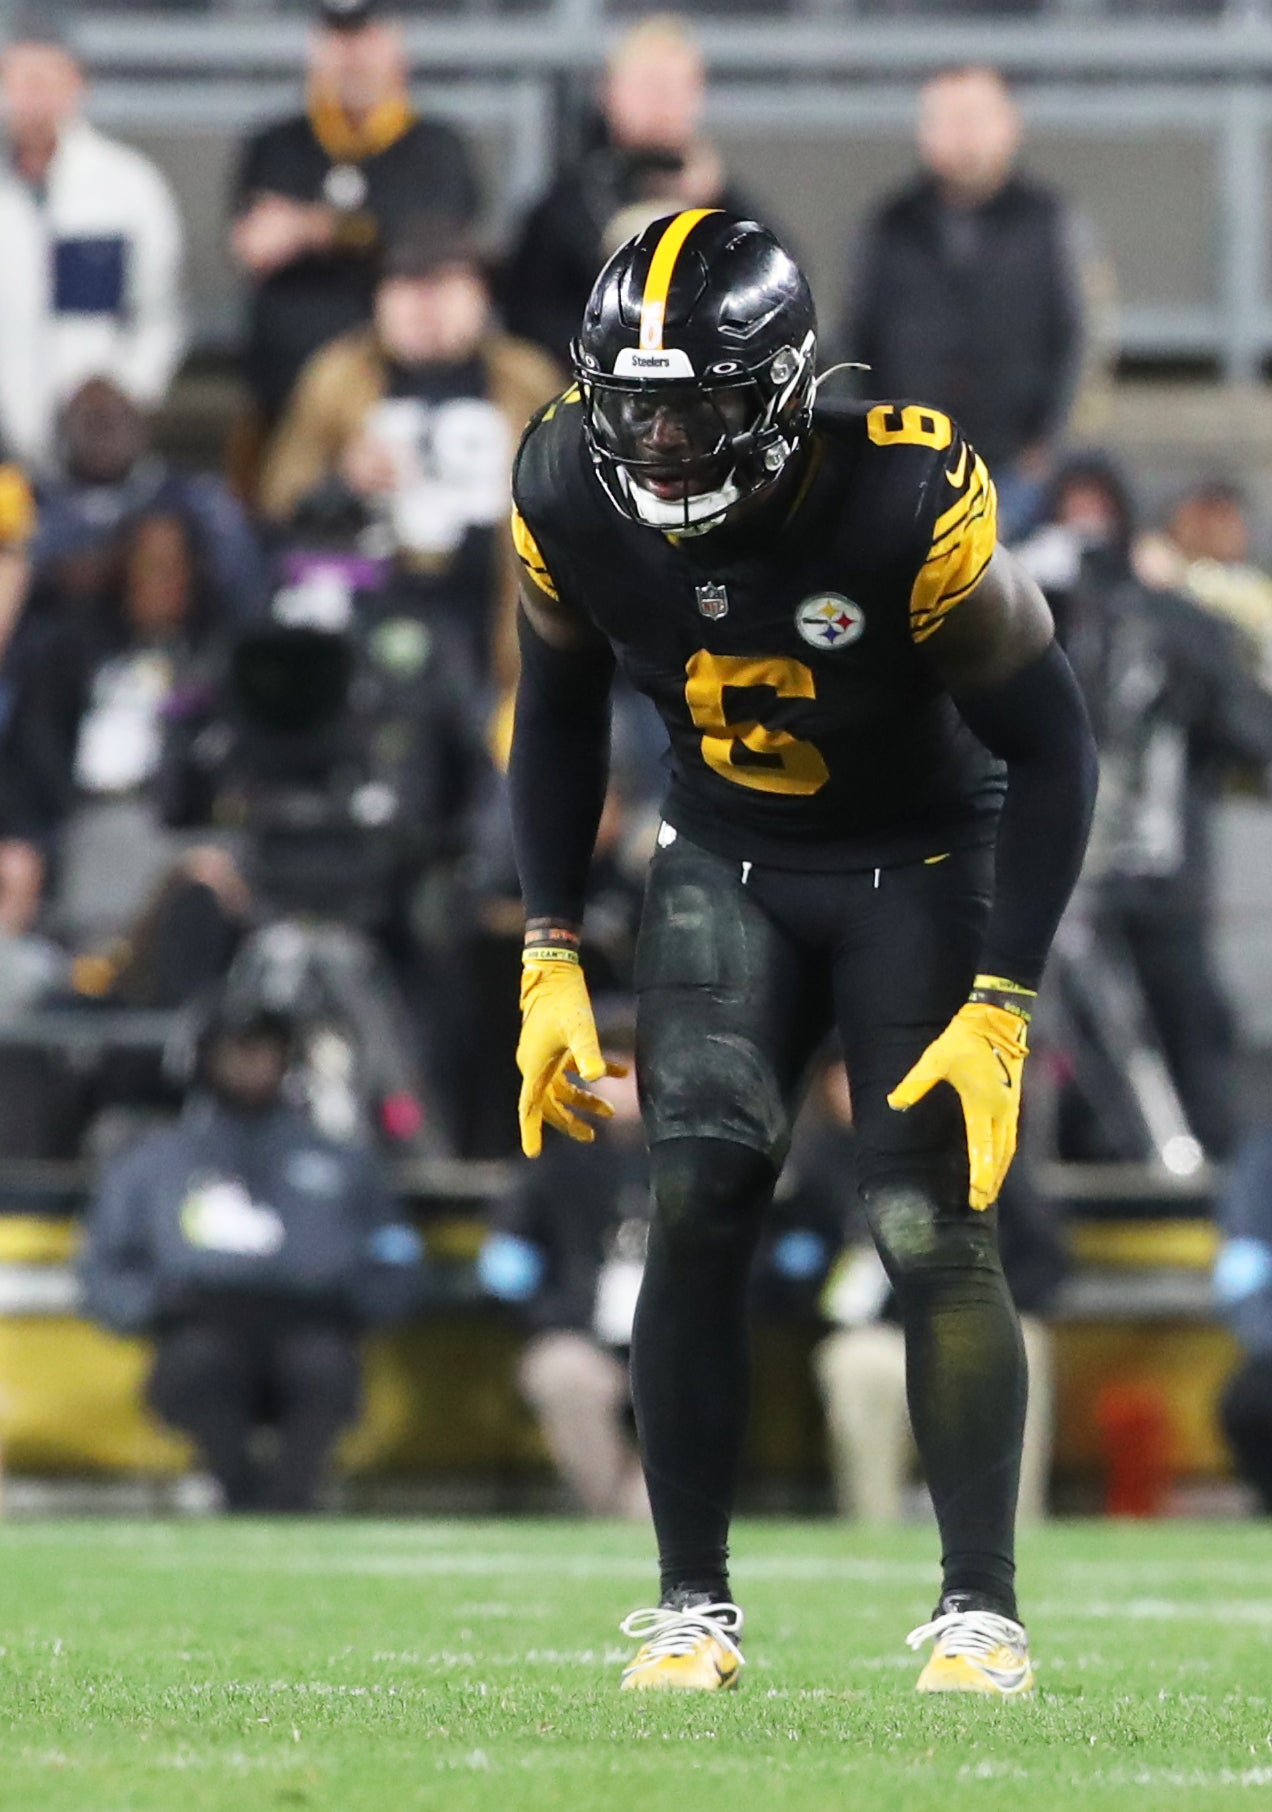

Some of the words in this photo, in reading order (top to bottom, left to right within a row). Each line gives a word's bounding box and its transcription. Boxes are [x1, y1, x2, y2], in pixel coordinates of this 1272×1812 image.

[631, 355, 670, 367] Steelers
[866, 404, 952, 451] 6
[685, 648, 830, 795] 6
